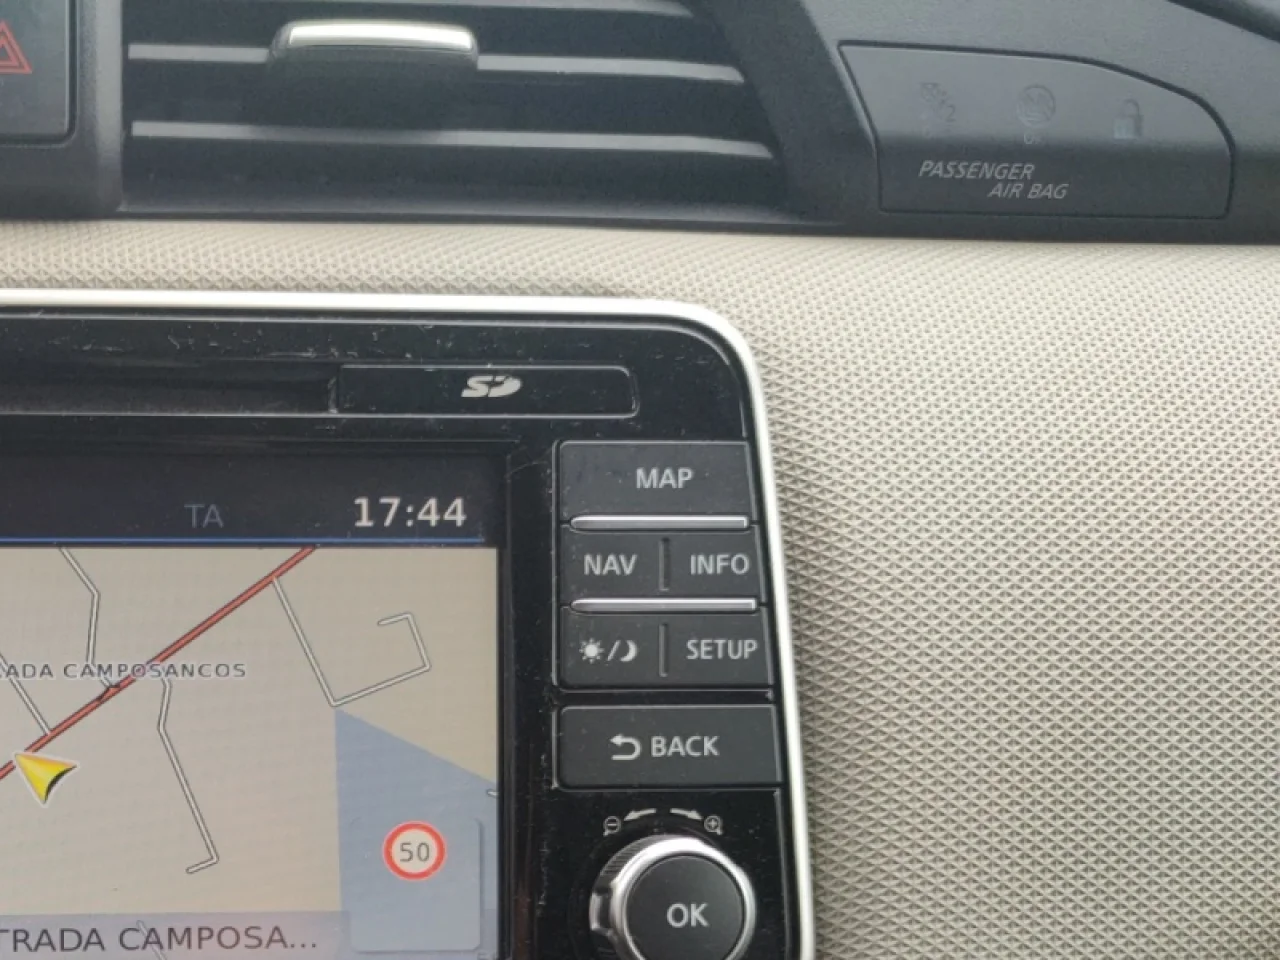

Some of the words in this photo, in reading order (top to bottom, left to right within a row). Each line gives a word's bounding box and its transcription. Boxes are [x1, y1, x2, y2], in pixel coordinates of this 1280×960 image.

[918, 160, 1035, 180] PASSENGER
[988, 182, 1022, 198] AIR
[1027, 183, 1070, 200] BAG
[635, 468, 695, 489] MAP
[185, 503, 224, 528] TA
[353, 497, 467, 527] 17:44
[584, 555, 638, 576] NAV
[689, 555, 750, 576] INFO
[687, 638, 758, 661] SETUP
[62, 661, 247, 681] CAMPOSANCOS
[651, 736, 719, 759] BACK
[399, 841, 430, 864] 50
[666, 905, 709, 928] OK
